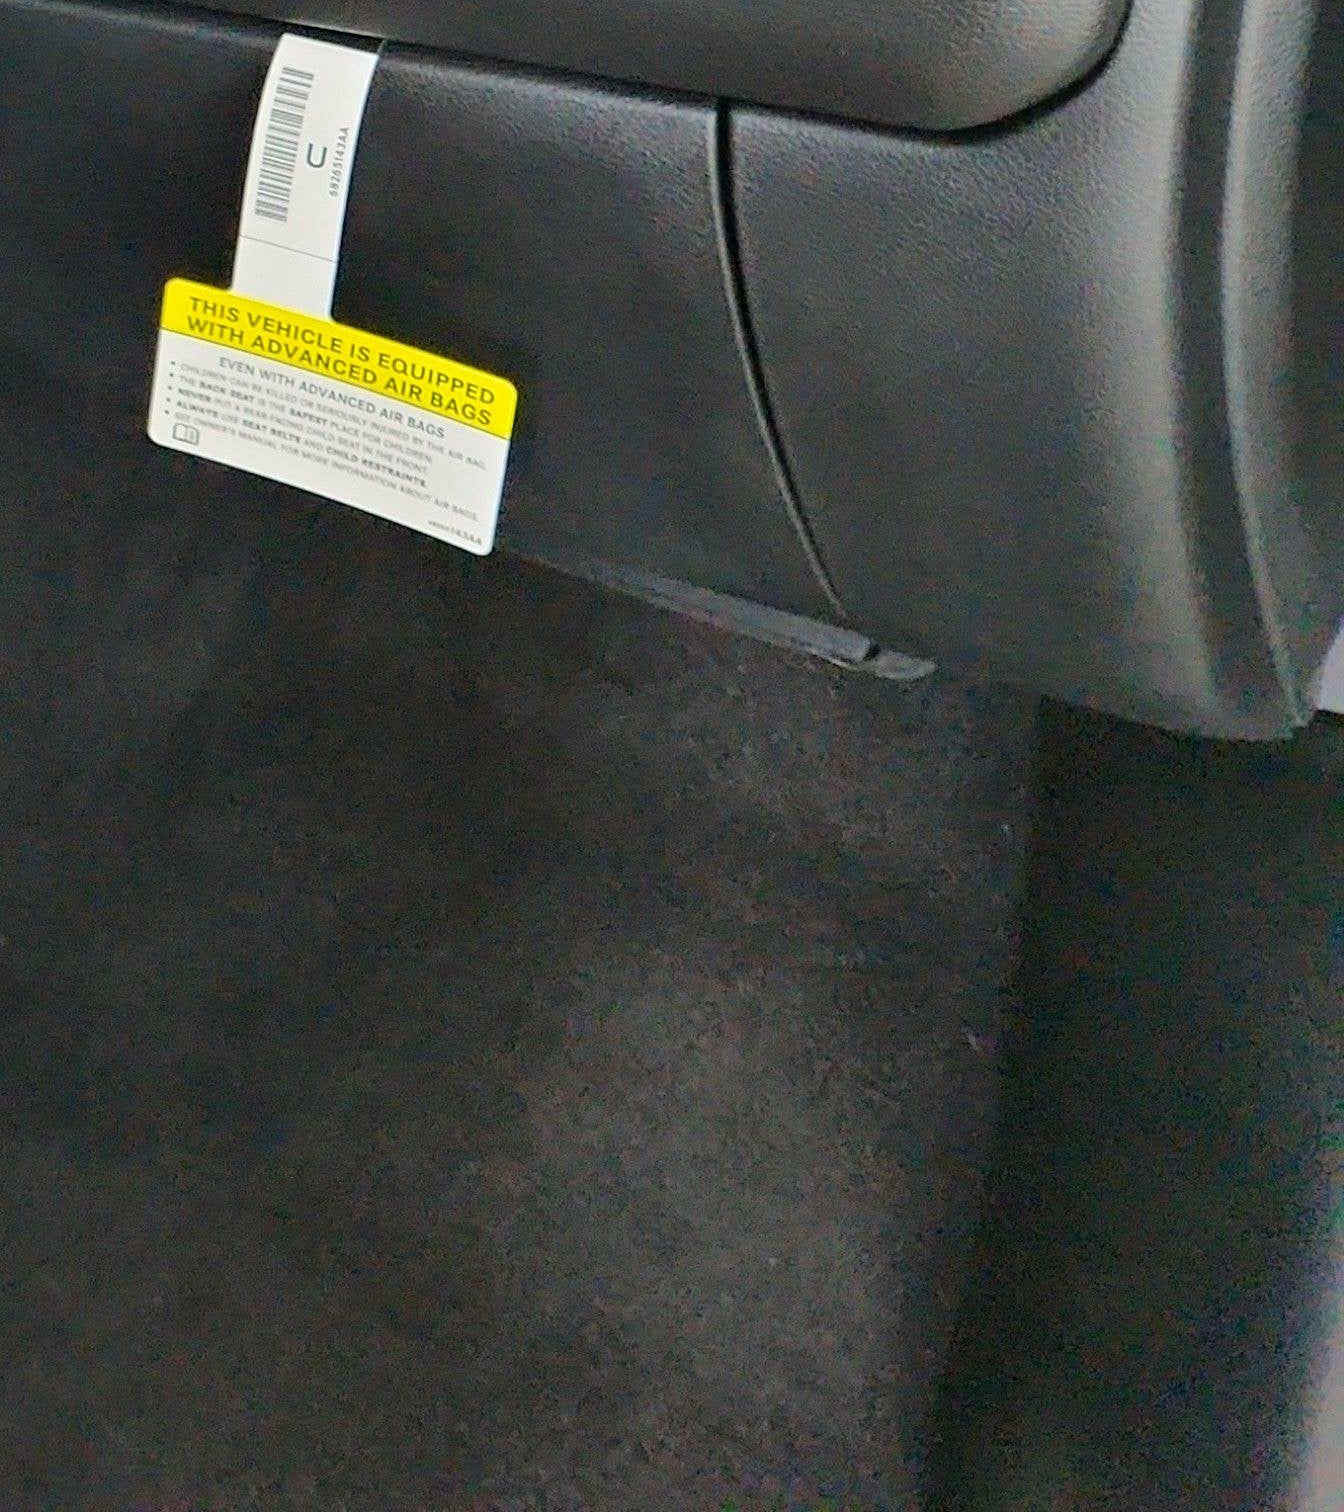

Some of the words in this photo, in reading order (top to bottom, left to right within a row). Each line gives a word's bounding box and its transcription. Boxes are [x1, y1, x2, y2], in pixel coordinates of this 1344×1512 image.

[307, 143, 327, 168] U
[186, 315, 242, 345] WITH
[252, 333, 376, 384] ADVANCED
[384, 376, 422, 400] AIR
[430, 392, 491, 425] BAGS
[189, 295, 239, 323] THIS
[247, 311, 341, 353] VEHICLE
[350, 343, 369, 362] IS
[378, 353, 494, 404] EQUIPPED
[178, 387, 210, 402] NEVER
[199, 380, 225, 394] BACK
[230, 390, 253, 402] SEAT
[290, 408, 326, 425] SAFEST
[330, 421, 359, 436] PLACE
[219, 356, 253, 375] EVEN
[260, 368, 293, 387] WITH
[300, 381, 375, 413] ADVANCED
[380, 407, 402, 422] AIR
[407, 417, 444, 438] BAGS
[177, 399, 217, 417] ALWAYS
[243, 420, 265, 432] SEAT
[271, 428, 299, 442] BELTS
[326, 446, 357, 462] CHILD
[428, 441, 443, 453] THE
[448, 449, 462, 459] AIR
